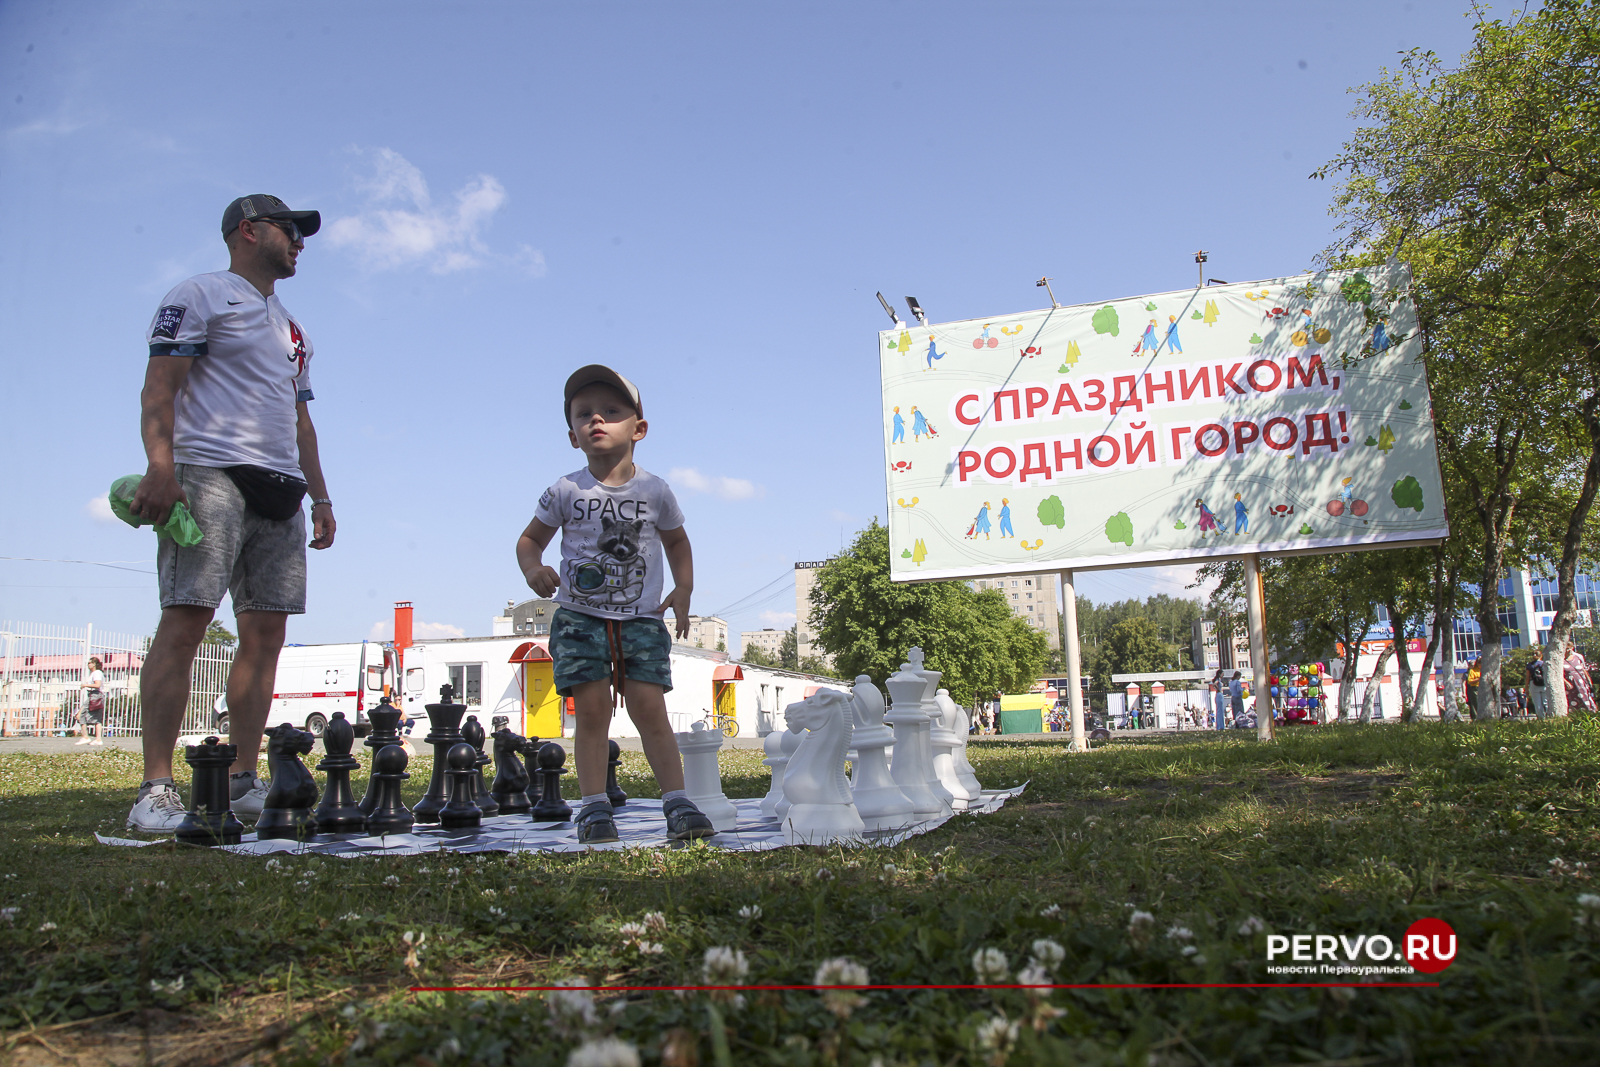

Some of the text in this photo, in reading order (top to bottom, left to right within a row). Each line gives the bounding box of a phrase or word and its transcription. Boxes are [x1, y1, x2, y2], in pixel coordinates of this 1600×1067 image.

[955, 353, 1342, 426] С ПРАЗДНИКОМ,
[958, 411, 1351, 483] РОДНОЙ ГОРОД!
[573, 497, 648, 523] SPACE
